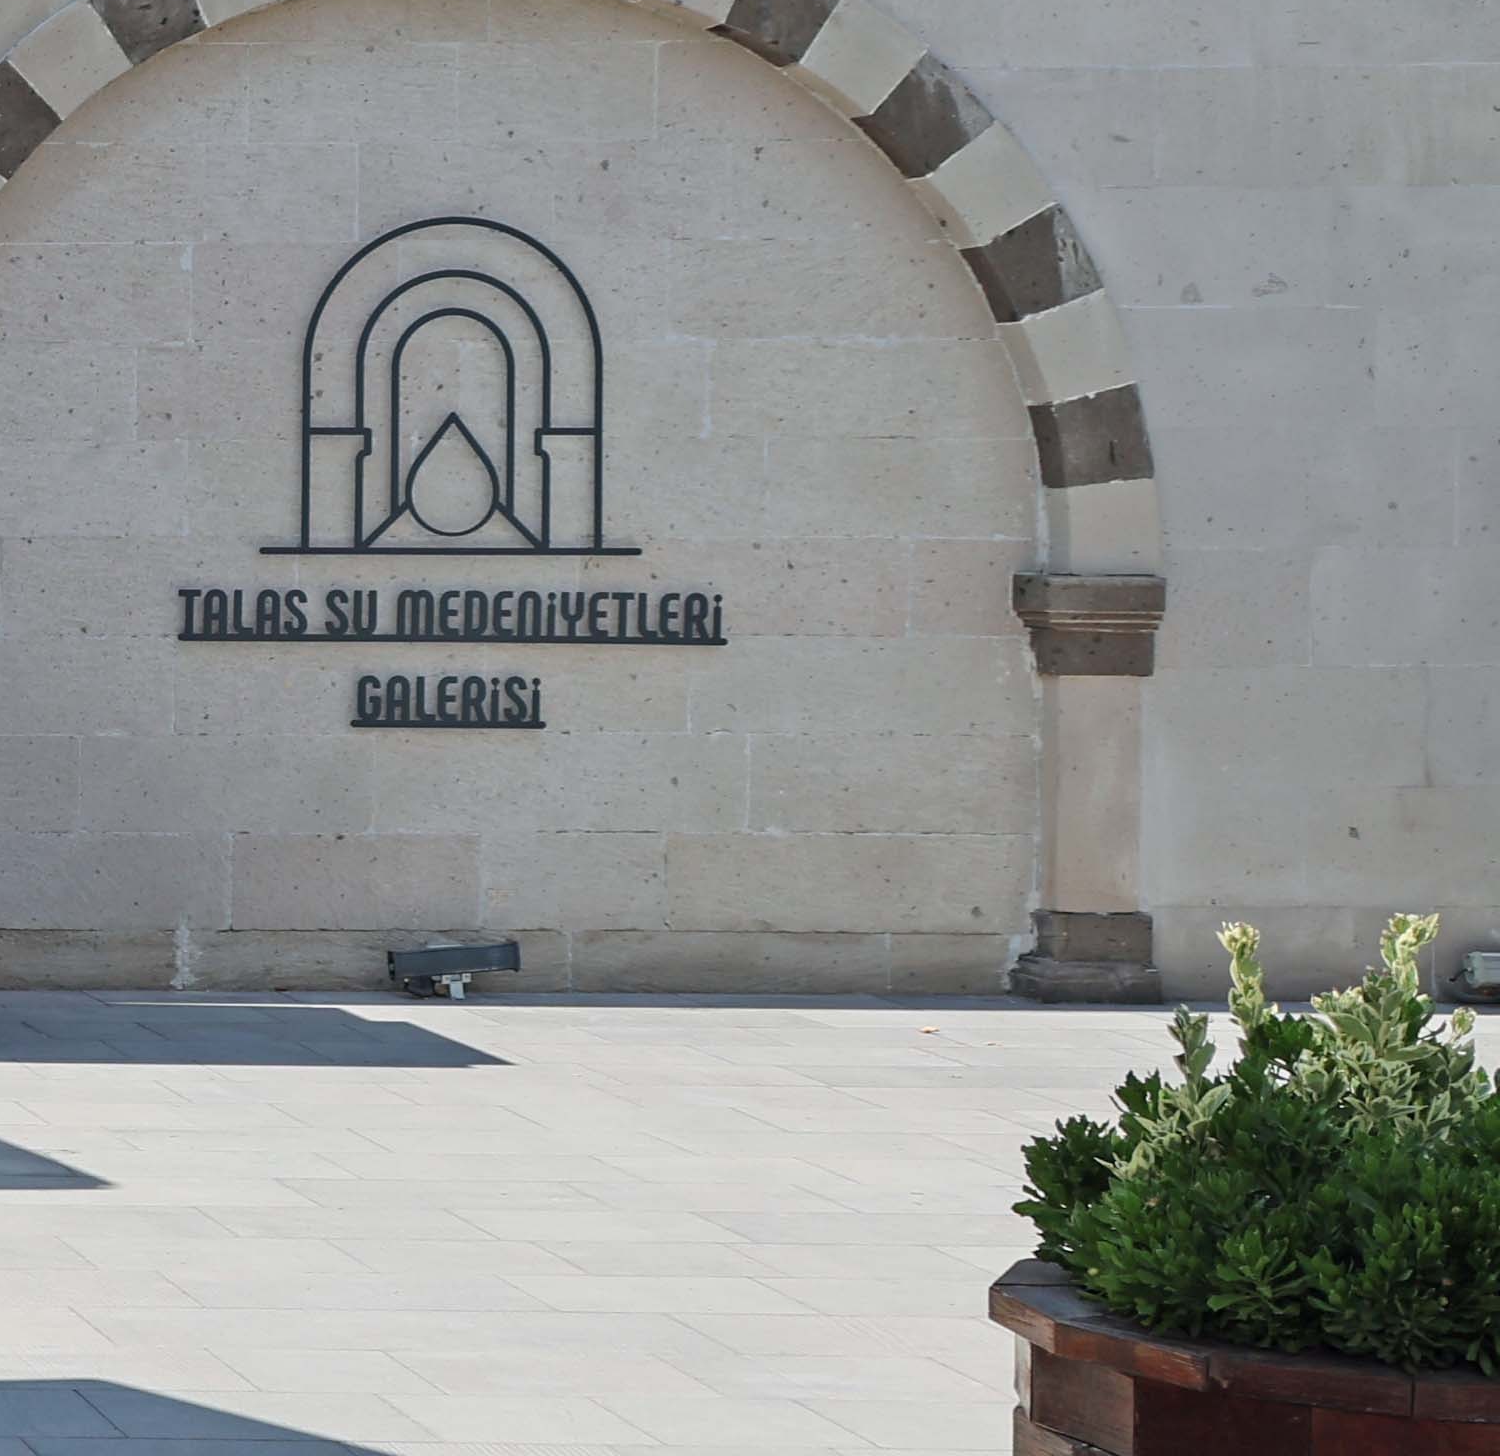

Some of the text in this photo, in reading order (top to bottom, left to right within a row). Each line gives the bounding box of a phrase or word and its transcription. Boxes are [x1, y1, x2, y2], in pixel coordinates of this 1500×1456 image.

[178, 589, 725, 641] TALAS SU MEDENİYETLERİ
[356, 675, 542, 726] GALERİSİ
